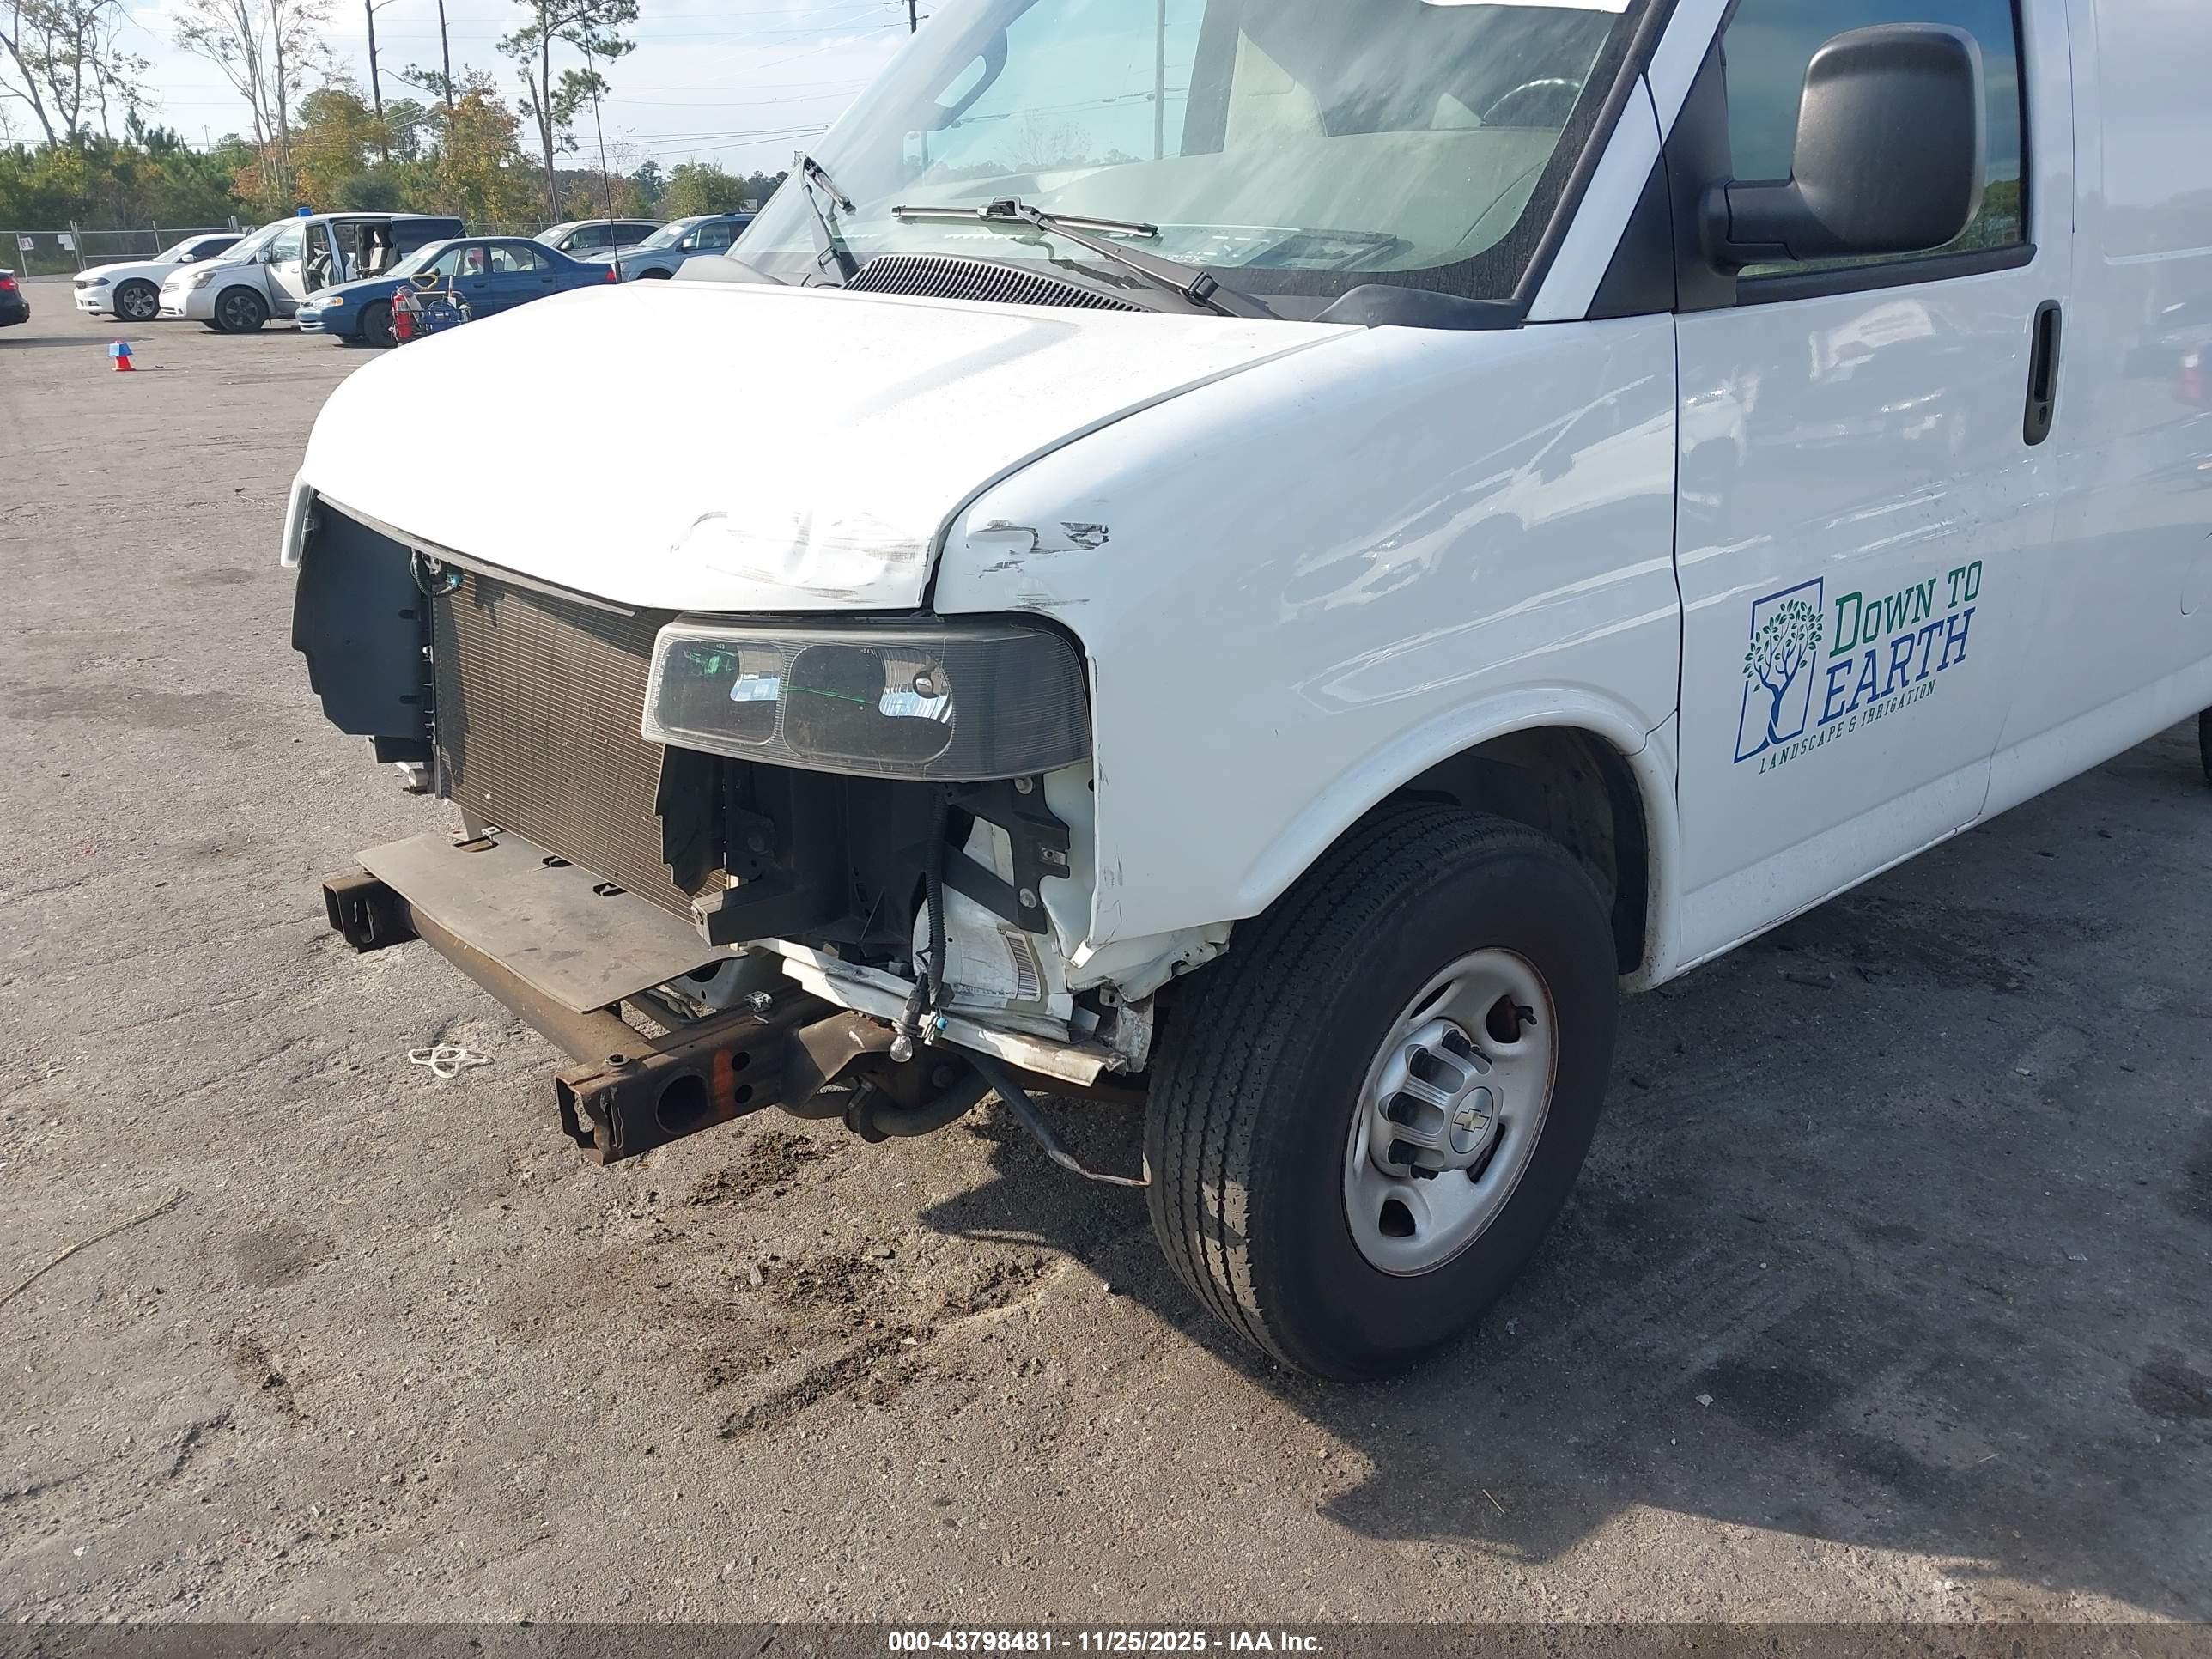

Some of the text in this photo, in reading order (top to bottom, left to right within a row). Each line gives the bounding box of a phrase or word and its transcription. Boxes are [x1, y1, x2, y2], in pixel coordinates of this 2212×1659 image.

[1829, 560, 1983, 659] DOWN TO
[1817, 606, 1976, 727] EARTH
[1759, 679, 1936, 775] LANDSCAPE & IRRIGATION
